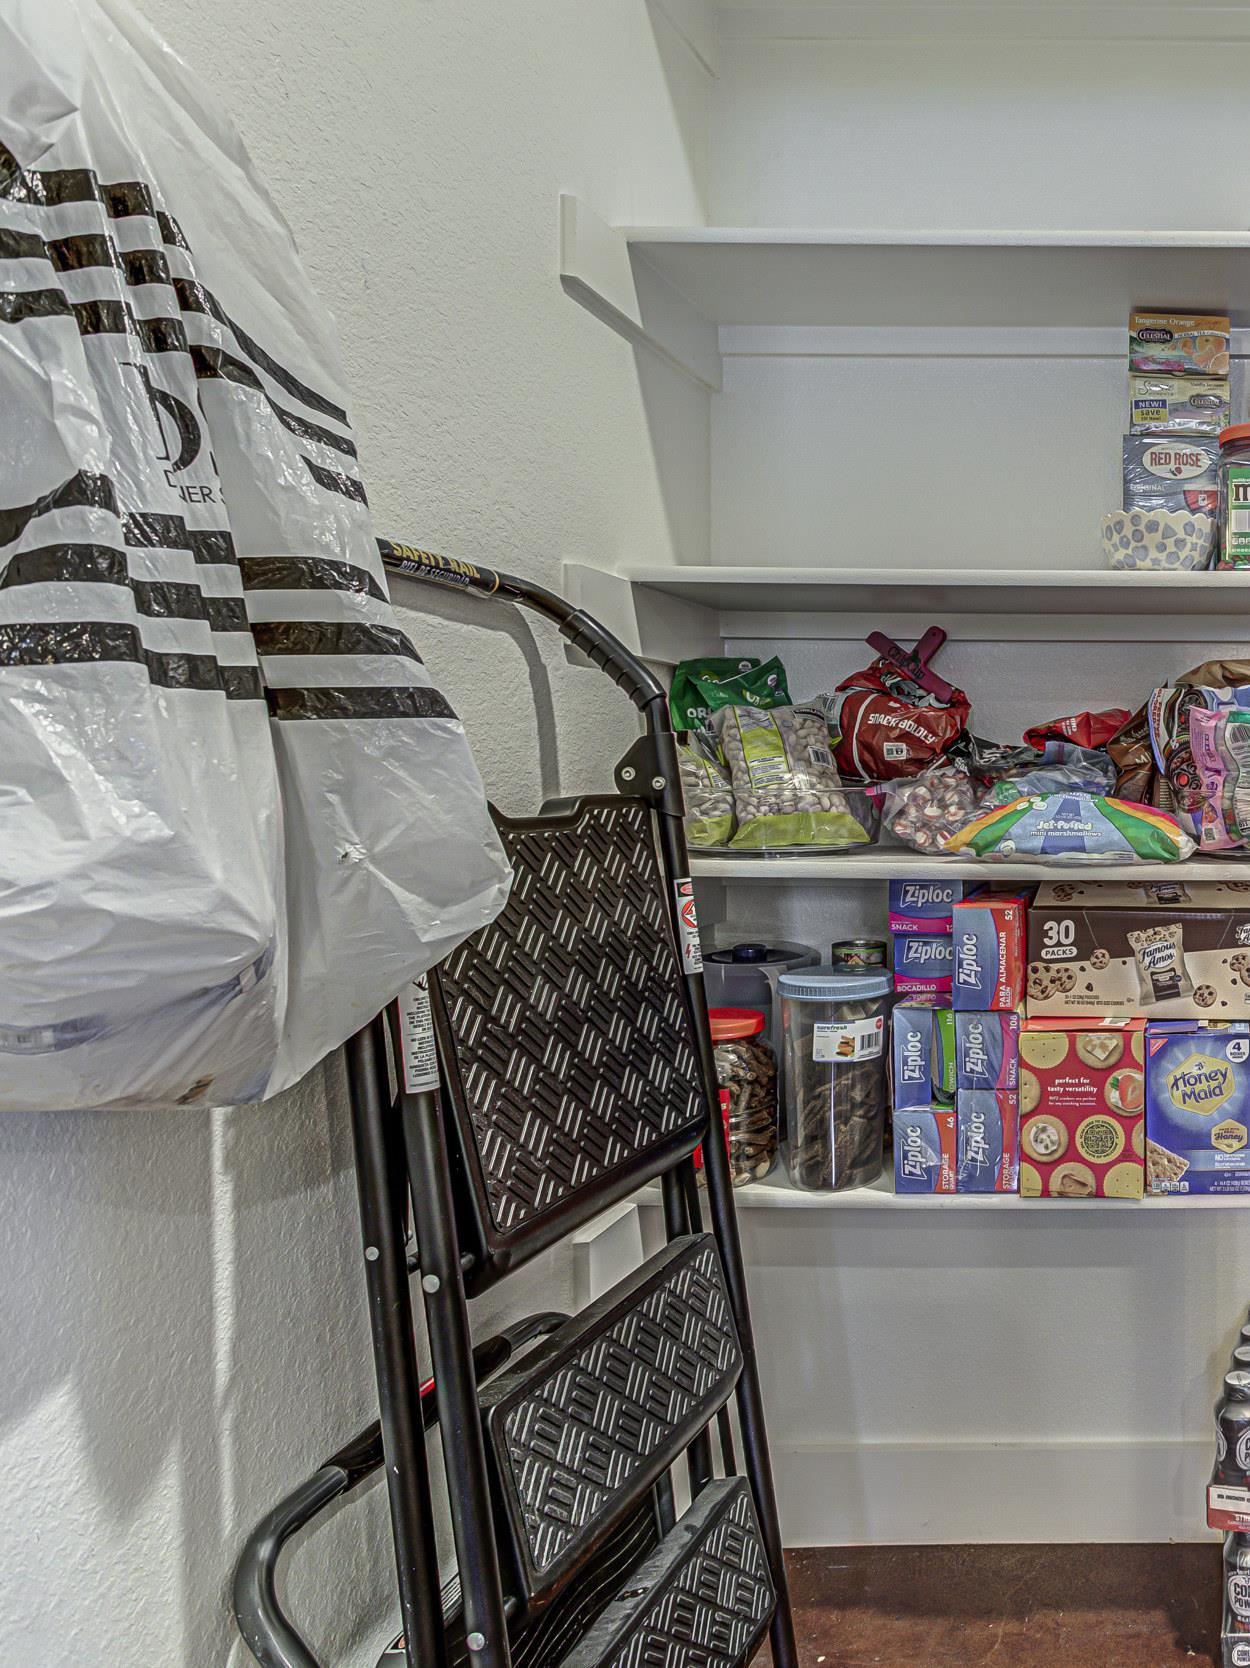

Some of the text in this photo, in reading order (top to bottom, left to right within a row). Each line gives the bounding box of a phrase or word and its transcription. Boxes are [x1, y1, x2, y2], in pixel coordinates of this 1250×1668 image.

[1135, 316, 1195, 326] Tangerine Orange
[1138, 332, 1171, 341] CELESTIAL
[1138, 400, 1163, 408] NEW!
[1151, 451, 1203, 468] RED ROSE
[390, 540, 481, 579] SAFETY RAIL
[429, 566, 471, 586] SEGURIDAD
[1036, 819, 1093, 830] Jet-Puffed
[904, 885, 953, 908] Ziploc
[1005, 909, 1013, 921] 52
[1042, 919, 1075, 946] 30
[908, 941, 953, 964] Ziploc
[958, 933, 982, 985] Ziploc
[1044, 948, 1073, 957] PACKS
[1138, 941, 1176, 963] Famous
[1144, 953, 1175, 969] Amos
[999, 931, 1007, 1008] PARA ALMACENAR
[896, 984, 937, 992] BOCADILLO
[904, 1031, 926, 1080] Ziploc
[966, 1022, 989, 1073] Ziploc
[1232, 1042, 1241, 1052] 4
[1055, 1077, 1078, 1085] perfect
[1171, 1066, 1229, 1092] Honey
[1009, 1094, 1017, 1105] 52
[1181, 1082, 1224, 1106] Maid
[946, 1116, 954, 1129] 46
[967, 1112, 989, 1161] Ziploc
[1214, 1133, 1244, 1143] Honey
[904, 1126, 927, 1175] Ziploc
[1215, 1153, 1224, 1161] NO
[1002, 1152, 1010, 1189] STORAGE
